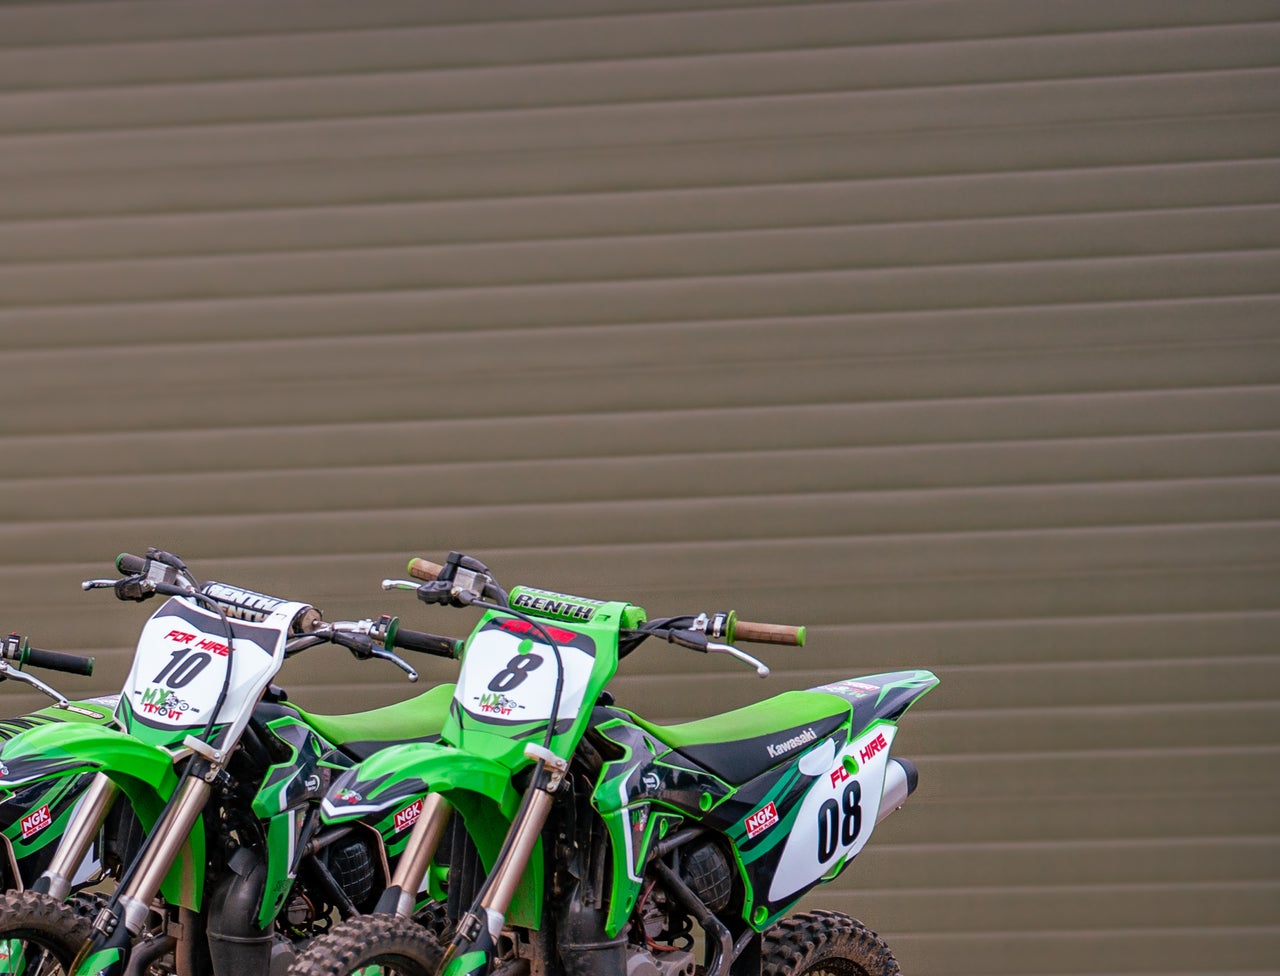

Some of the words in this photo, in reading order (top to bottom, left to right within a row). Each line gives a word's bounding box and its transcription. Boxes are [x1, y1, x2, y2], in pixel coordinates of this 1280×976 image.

[208, 584, 278, 611] RENTH
[514, 594, 594, 620] RENTH
[163, 630, 197, 645] FOR
[195, 638, 237, 657] HIRE
[152, 648, 212, 689] 10
[487, 652, 544, 692] 8
[143, 703, 184, 721] TRYOUT
[766, 727, 817, 759] Kawasaki
[830, 756, 855, 789] FO
[859, 732, 888, 765] HIRE
[23, 807, 48, 832] NGK
[397, 802, 420, 826] NGK
[748, 805, 774, 831] NGK
[816, 780, 862, 865] 08
